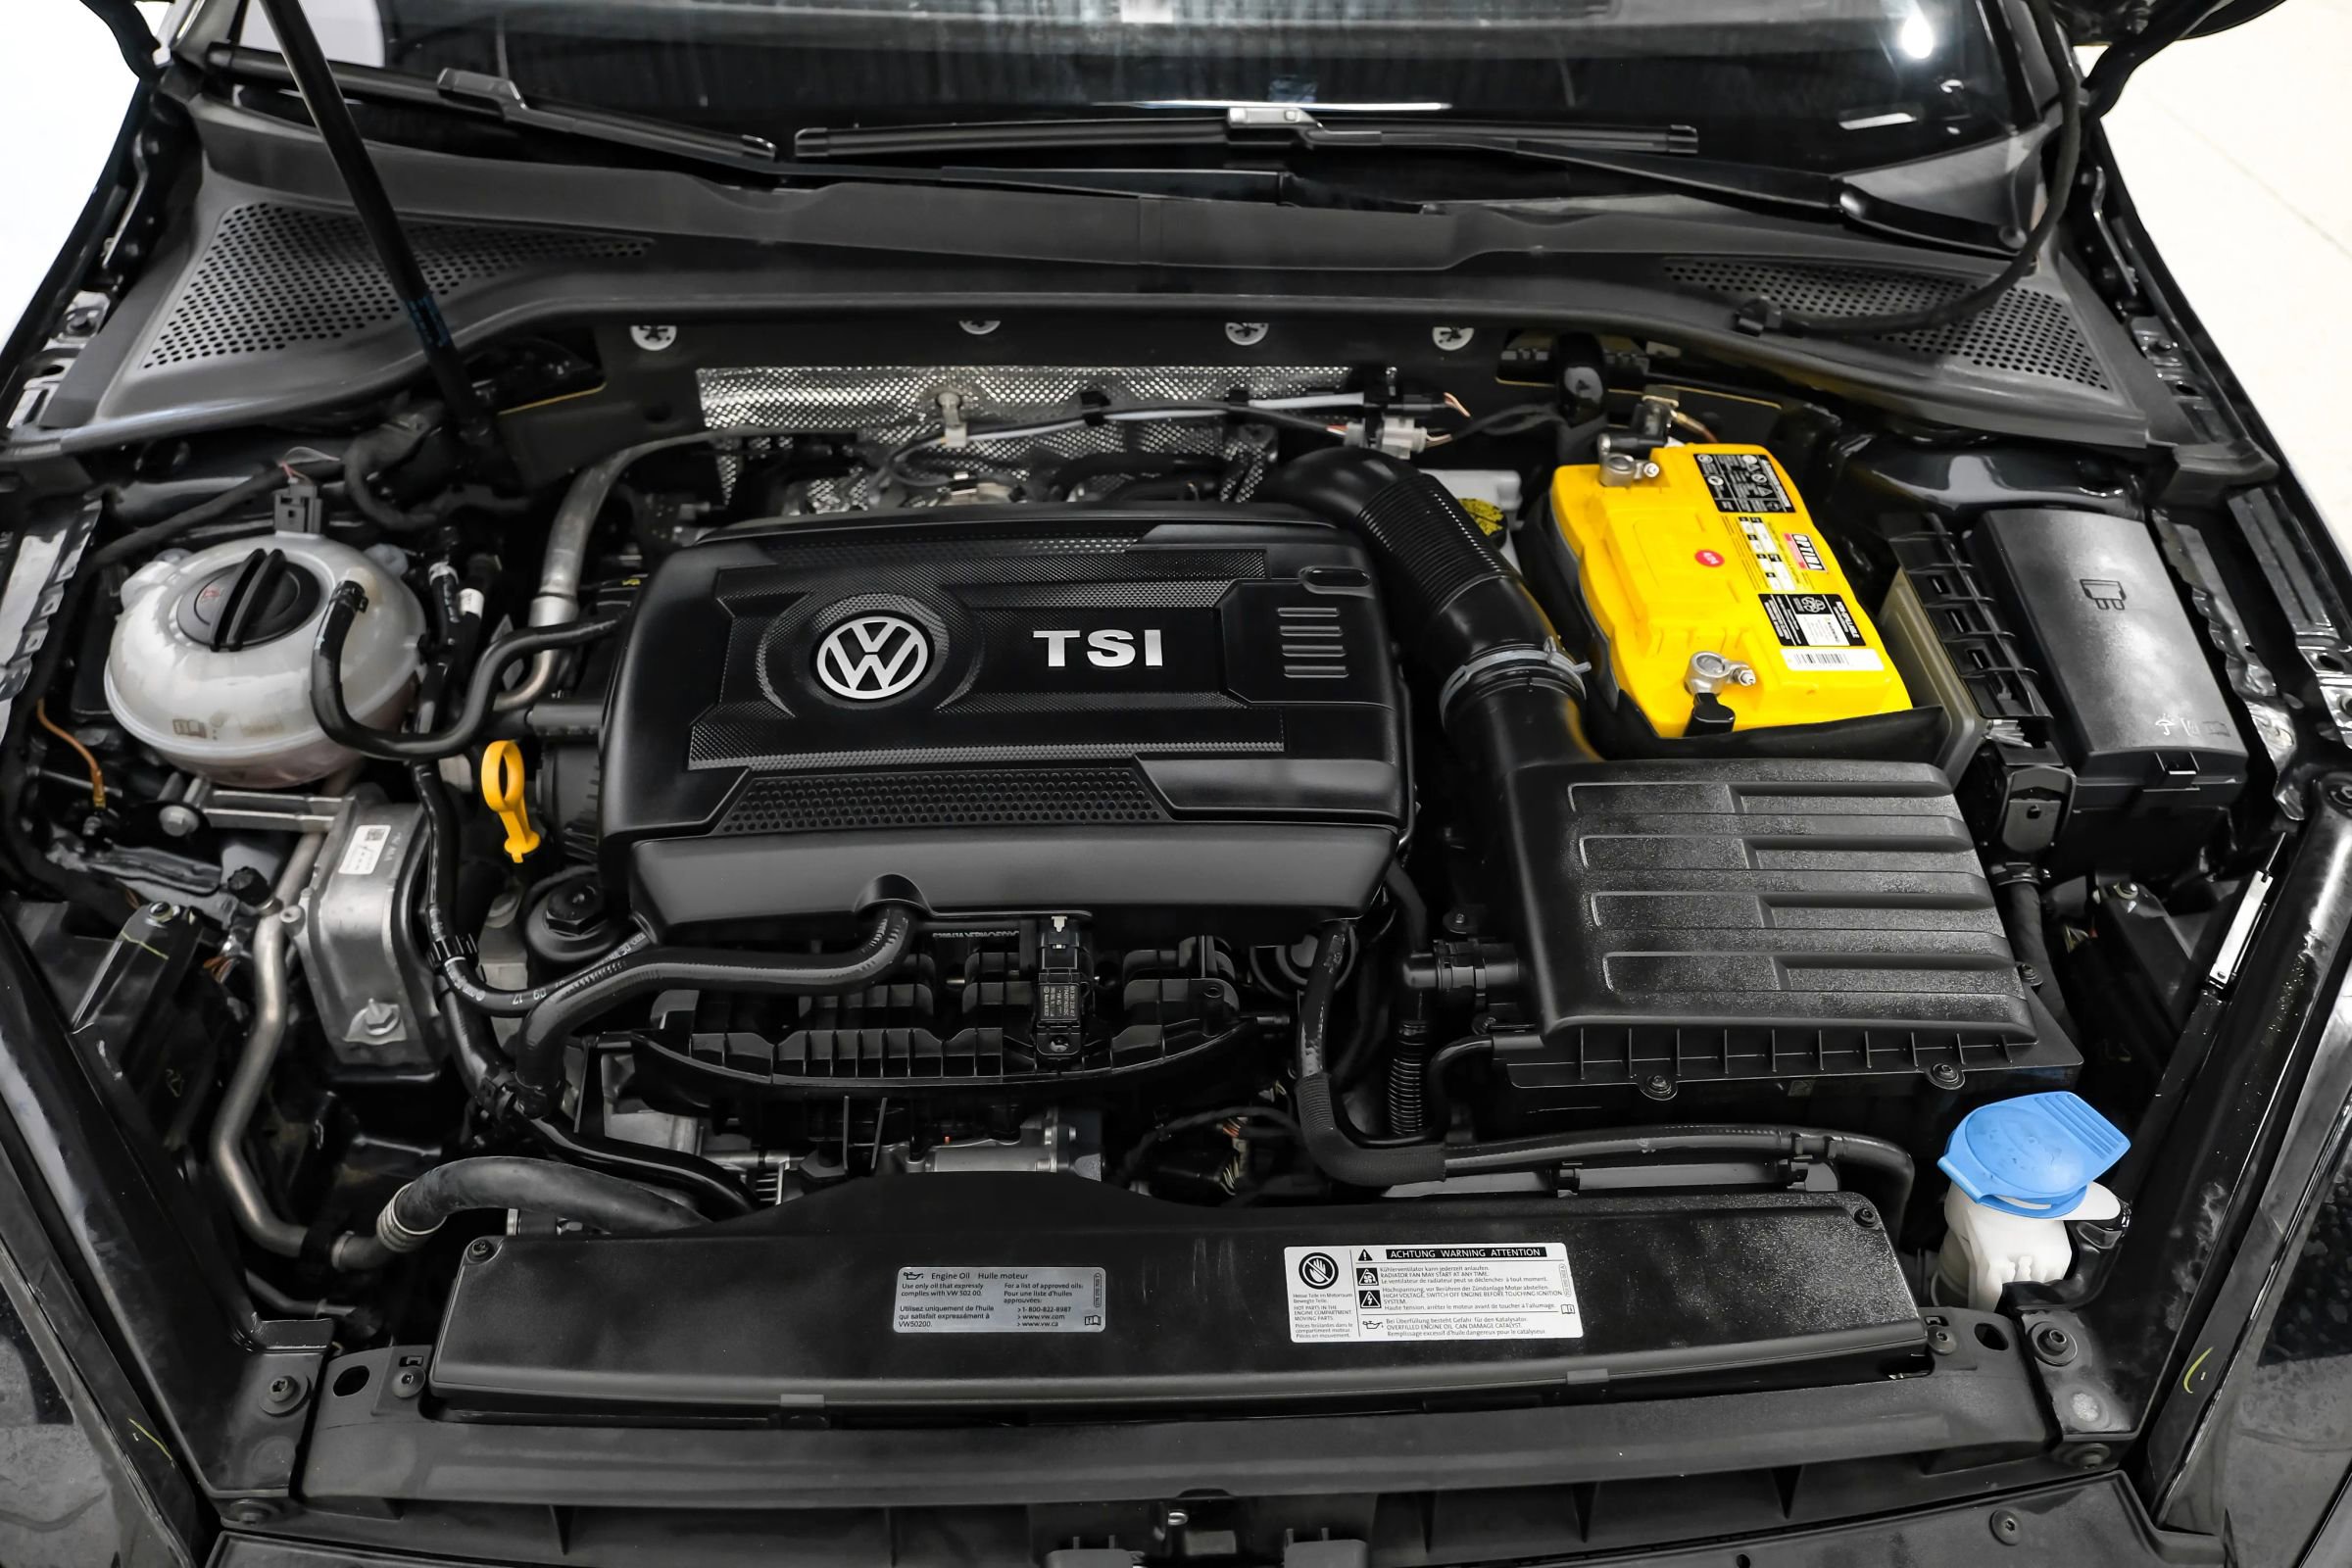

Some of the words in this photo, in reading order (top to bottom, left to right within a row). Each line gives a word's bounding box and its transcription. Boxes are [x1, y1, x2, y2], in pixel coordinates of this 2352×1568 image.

[817, 616, 928, 700] VW
[1033, 630, 1162, 667] TSI
[1390, 1249, 1435, 1258] ACHTUNG
[1441, 1249, 1485, 1258] WARNING
[1491, 1248, 1540, 1257] ATTENTION
[931, 1273, 957, 1281] Engine
